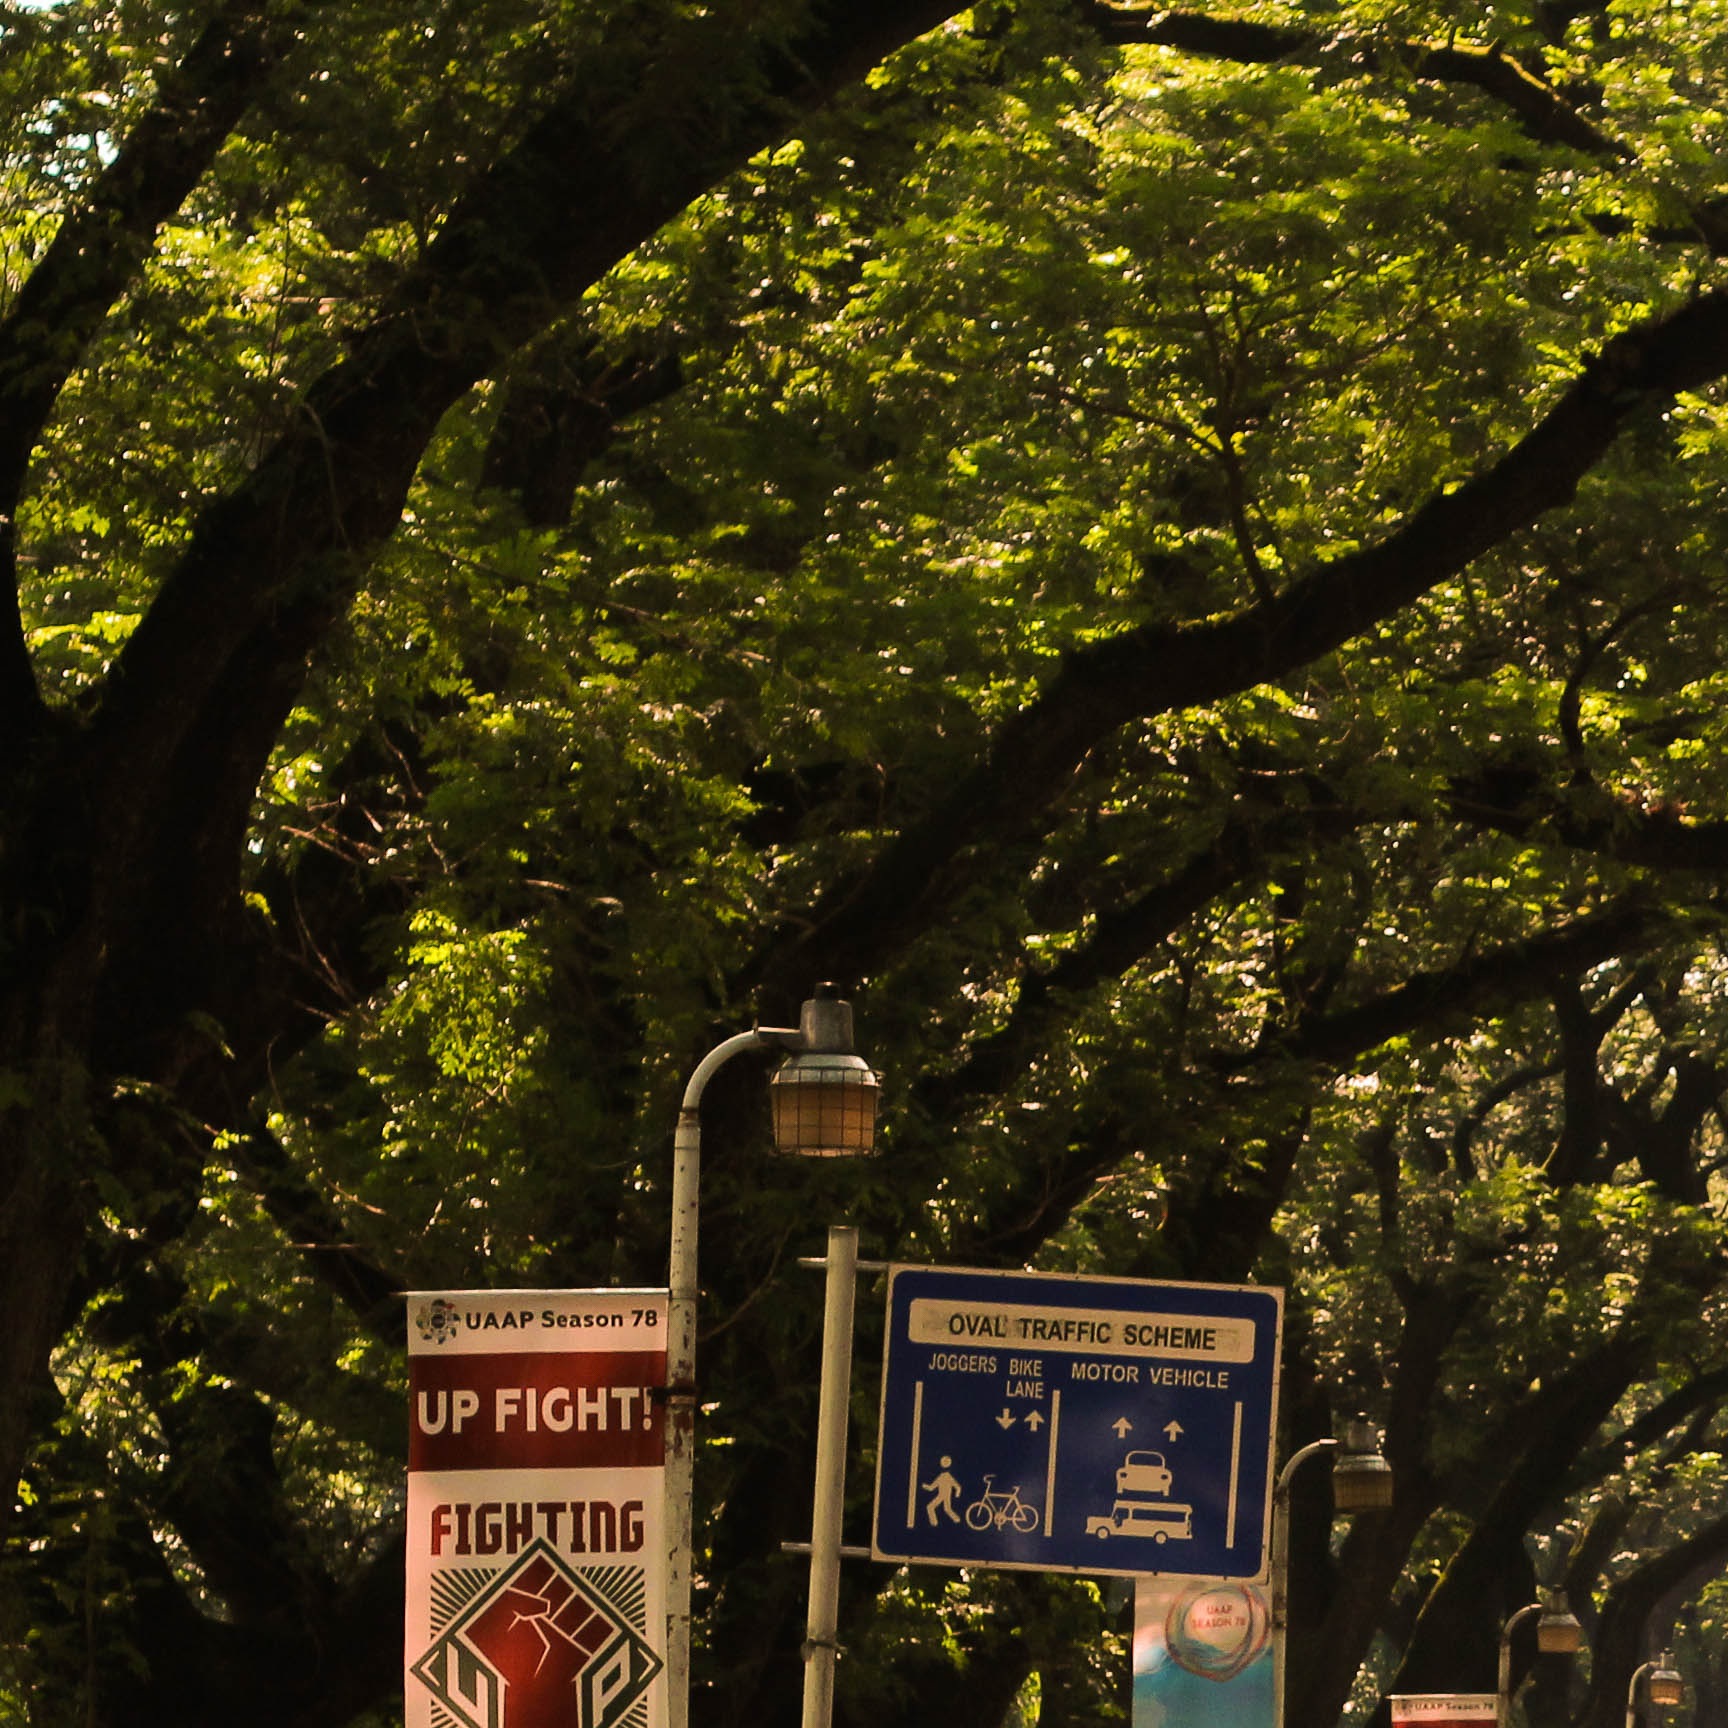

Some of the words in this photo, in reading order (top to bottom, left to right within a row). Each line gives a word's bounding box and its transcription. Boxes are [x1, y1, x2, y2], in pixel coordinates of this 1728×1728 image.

[465, 1311, 534, 1331] UAAP
[541, 1309, 624, 1330] Season
[631, 1309, 659, 1328] 78
[948, 1313, 1006, 1338] OVAL
[1019, 1317, 1111, 1344] TRAFFIC
[1124, 1323, 1217, 1351] SCHEME
[928, 1353, 998, 1374] JOGGERS
[1008, 1357, 1043, 1378] BIKE
[1071, 1362, 1139, 1384] MOTOR
[1150, 1367, 1230, 1390] VEHICLE
[1006, 1381, 1044, 1400] LANE
[417, 1389, 479, 1436] UP
[495, 1386, 654, 1434] FIGHT!
[431, 1500, 645, 1557] FIGHTING
